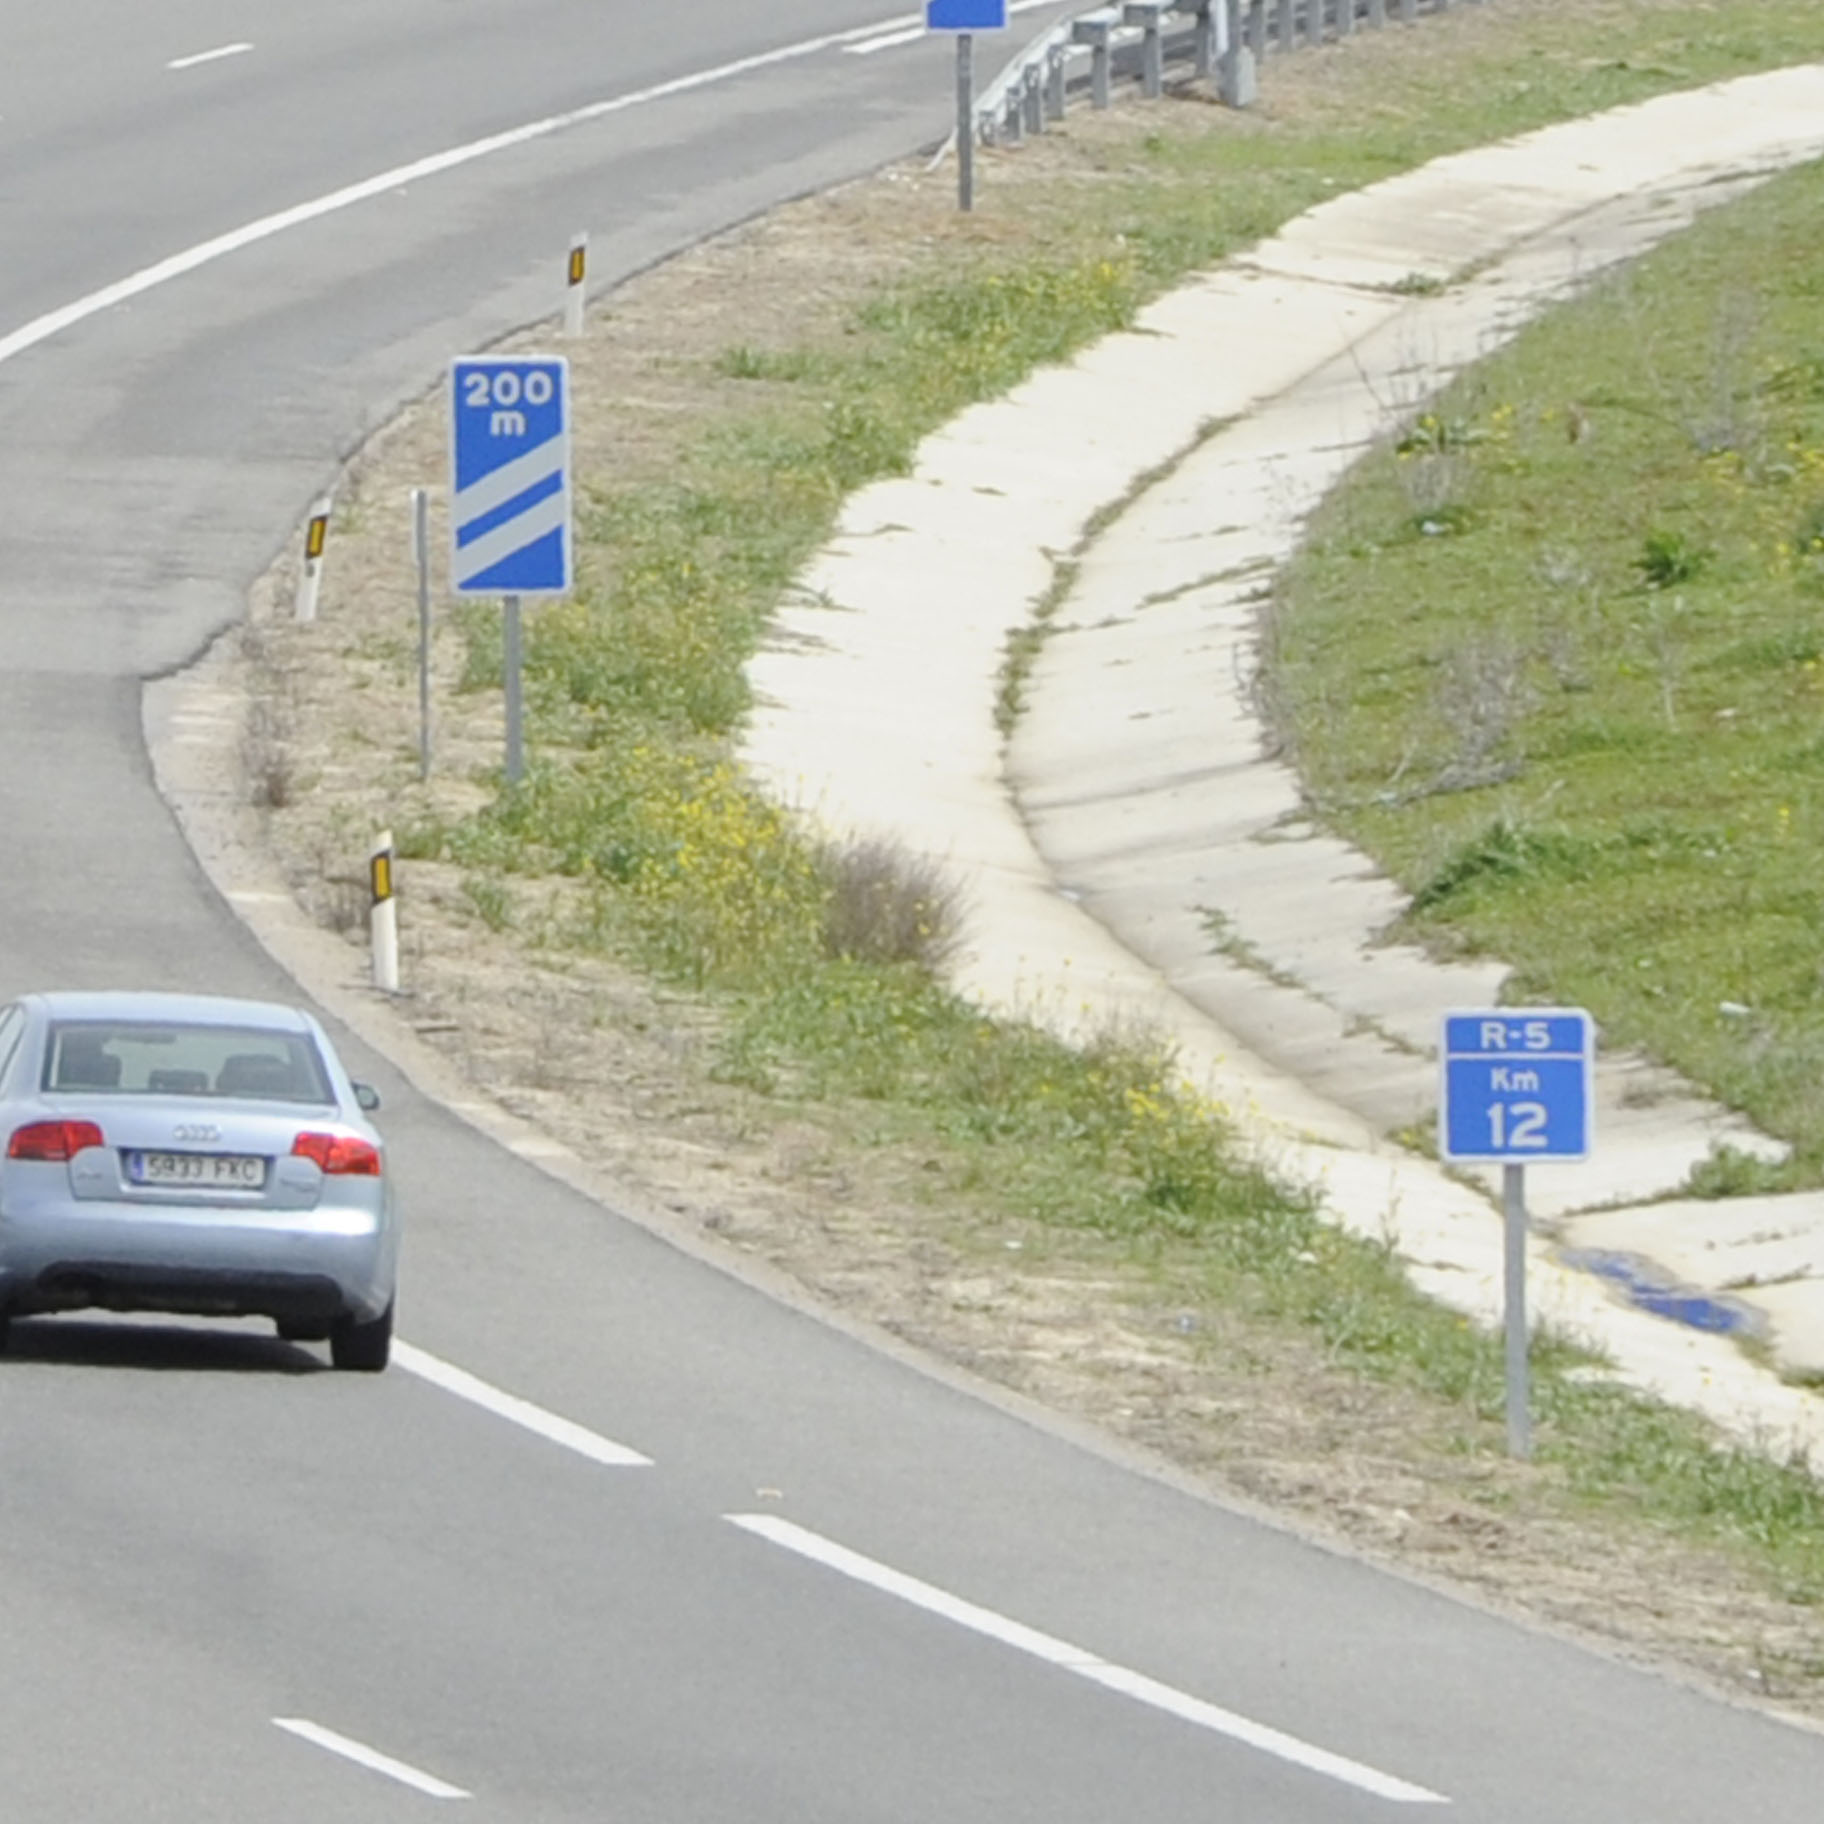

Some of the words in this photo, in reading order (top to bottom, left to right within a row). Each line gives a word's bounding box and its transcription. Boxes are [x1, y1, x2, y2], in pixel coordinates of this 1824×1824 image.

[463, 371, 554, 407] 200
[490, 410, 527, 437] m
[1480, 1021, 1552, 1050] R-5
[1490, 1066, 1541, 1092] Km
[1485, 1101, 1549, 1149] 12
